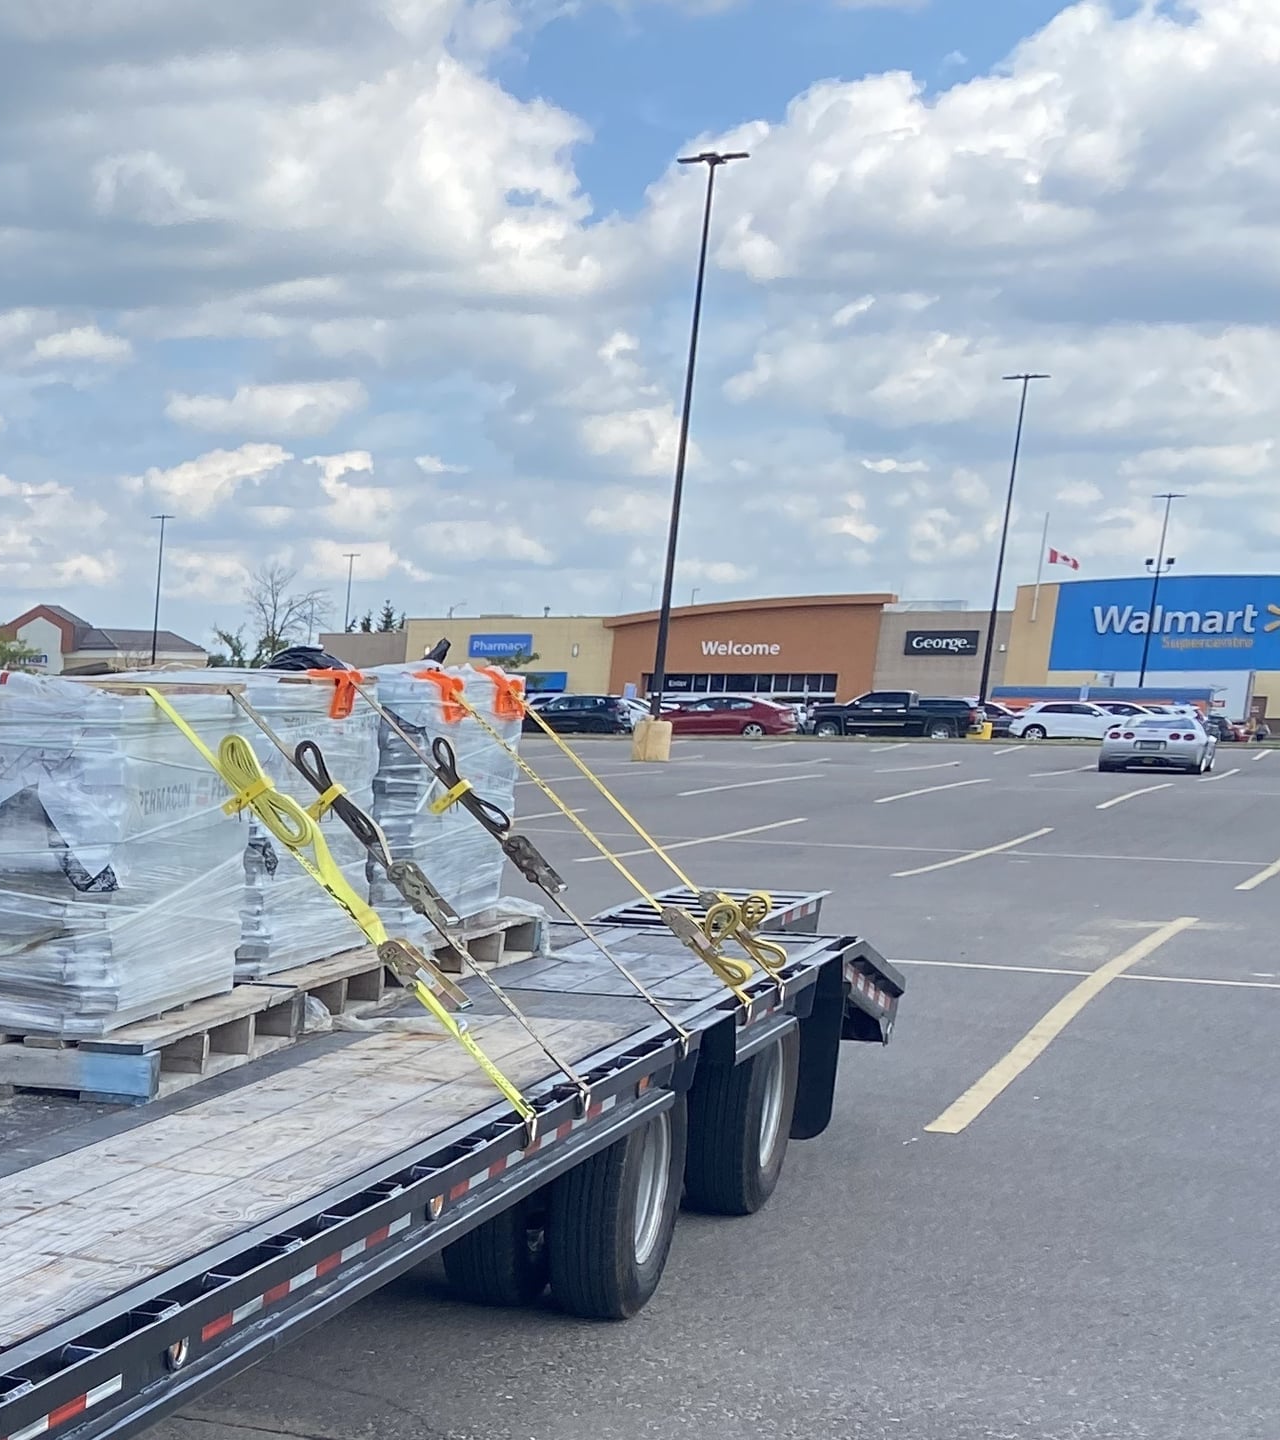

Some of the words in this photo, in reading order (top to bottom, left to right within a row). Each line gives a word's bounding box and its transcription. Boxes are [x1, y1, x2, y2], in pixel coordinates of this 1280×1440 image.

[1093, 604, 1259, 635] Walmart
[701, 640, 781, 656] Welcome
[139, 783, 190, 816] PERMACON
